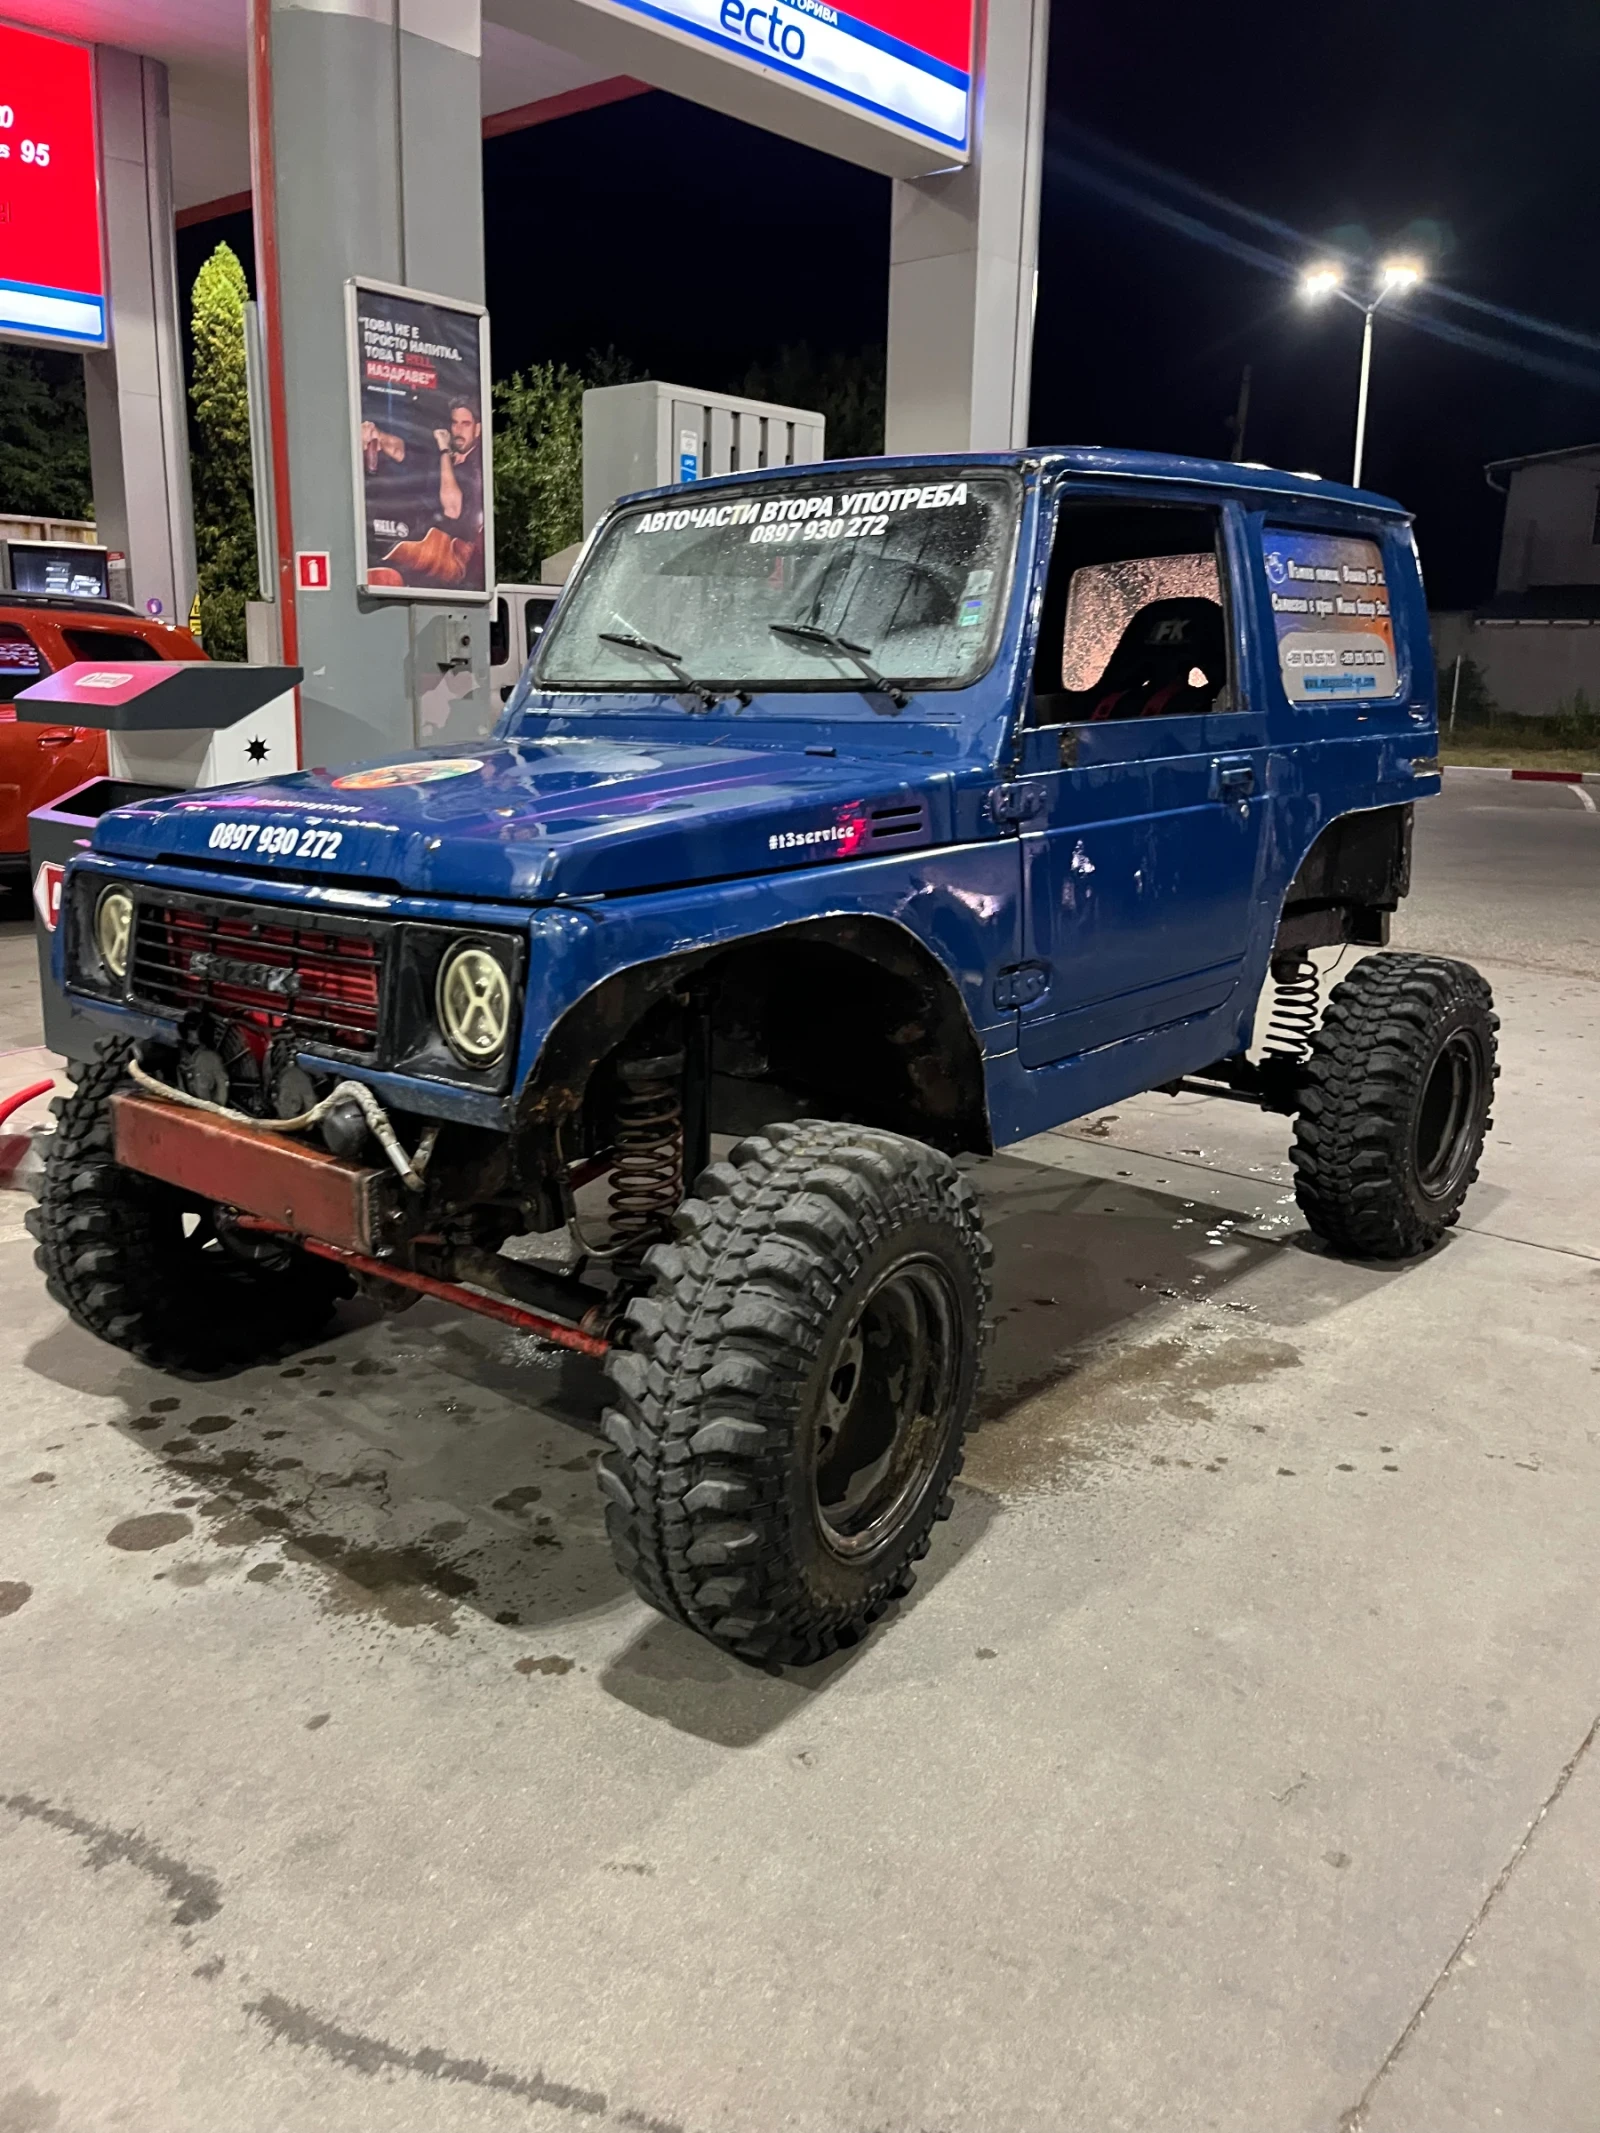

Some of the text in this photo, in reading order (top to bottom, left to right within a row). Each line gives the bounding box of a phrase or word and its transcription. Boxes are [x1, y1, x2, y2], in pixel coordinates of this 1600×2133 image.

[720, 0, 805, 60] ecto
[20, 139, 50, 167] 95
[364, 331, 462, 361] ПРОСТО НАПИТКА.
[395, 323, 410, 337] НЕ
[412, 326, 420, 339] Е
[364, 345, 394, 362] ТОВА
[395, 351, 404, 363] Е
[635, 483, 968, 534] АВТОЧАСТИ ВТОРА УПОТРЕБА
[750, 514, 889, 544] 0897 930 272
[208, 822, 343, 860] 0897 930 272
